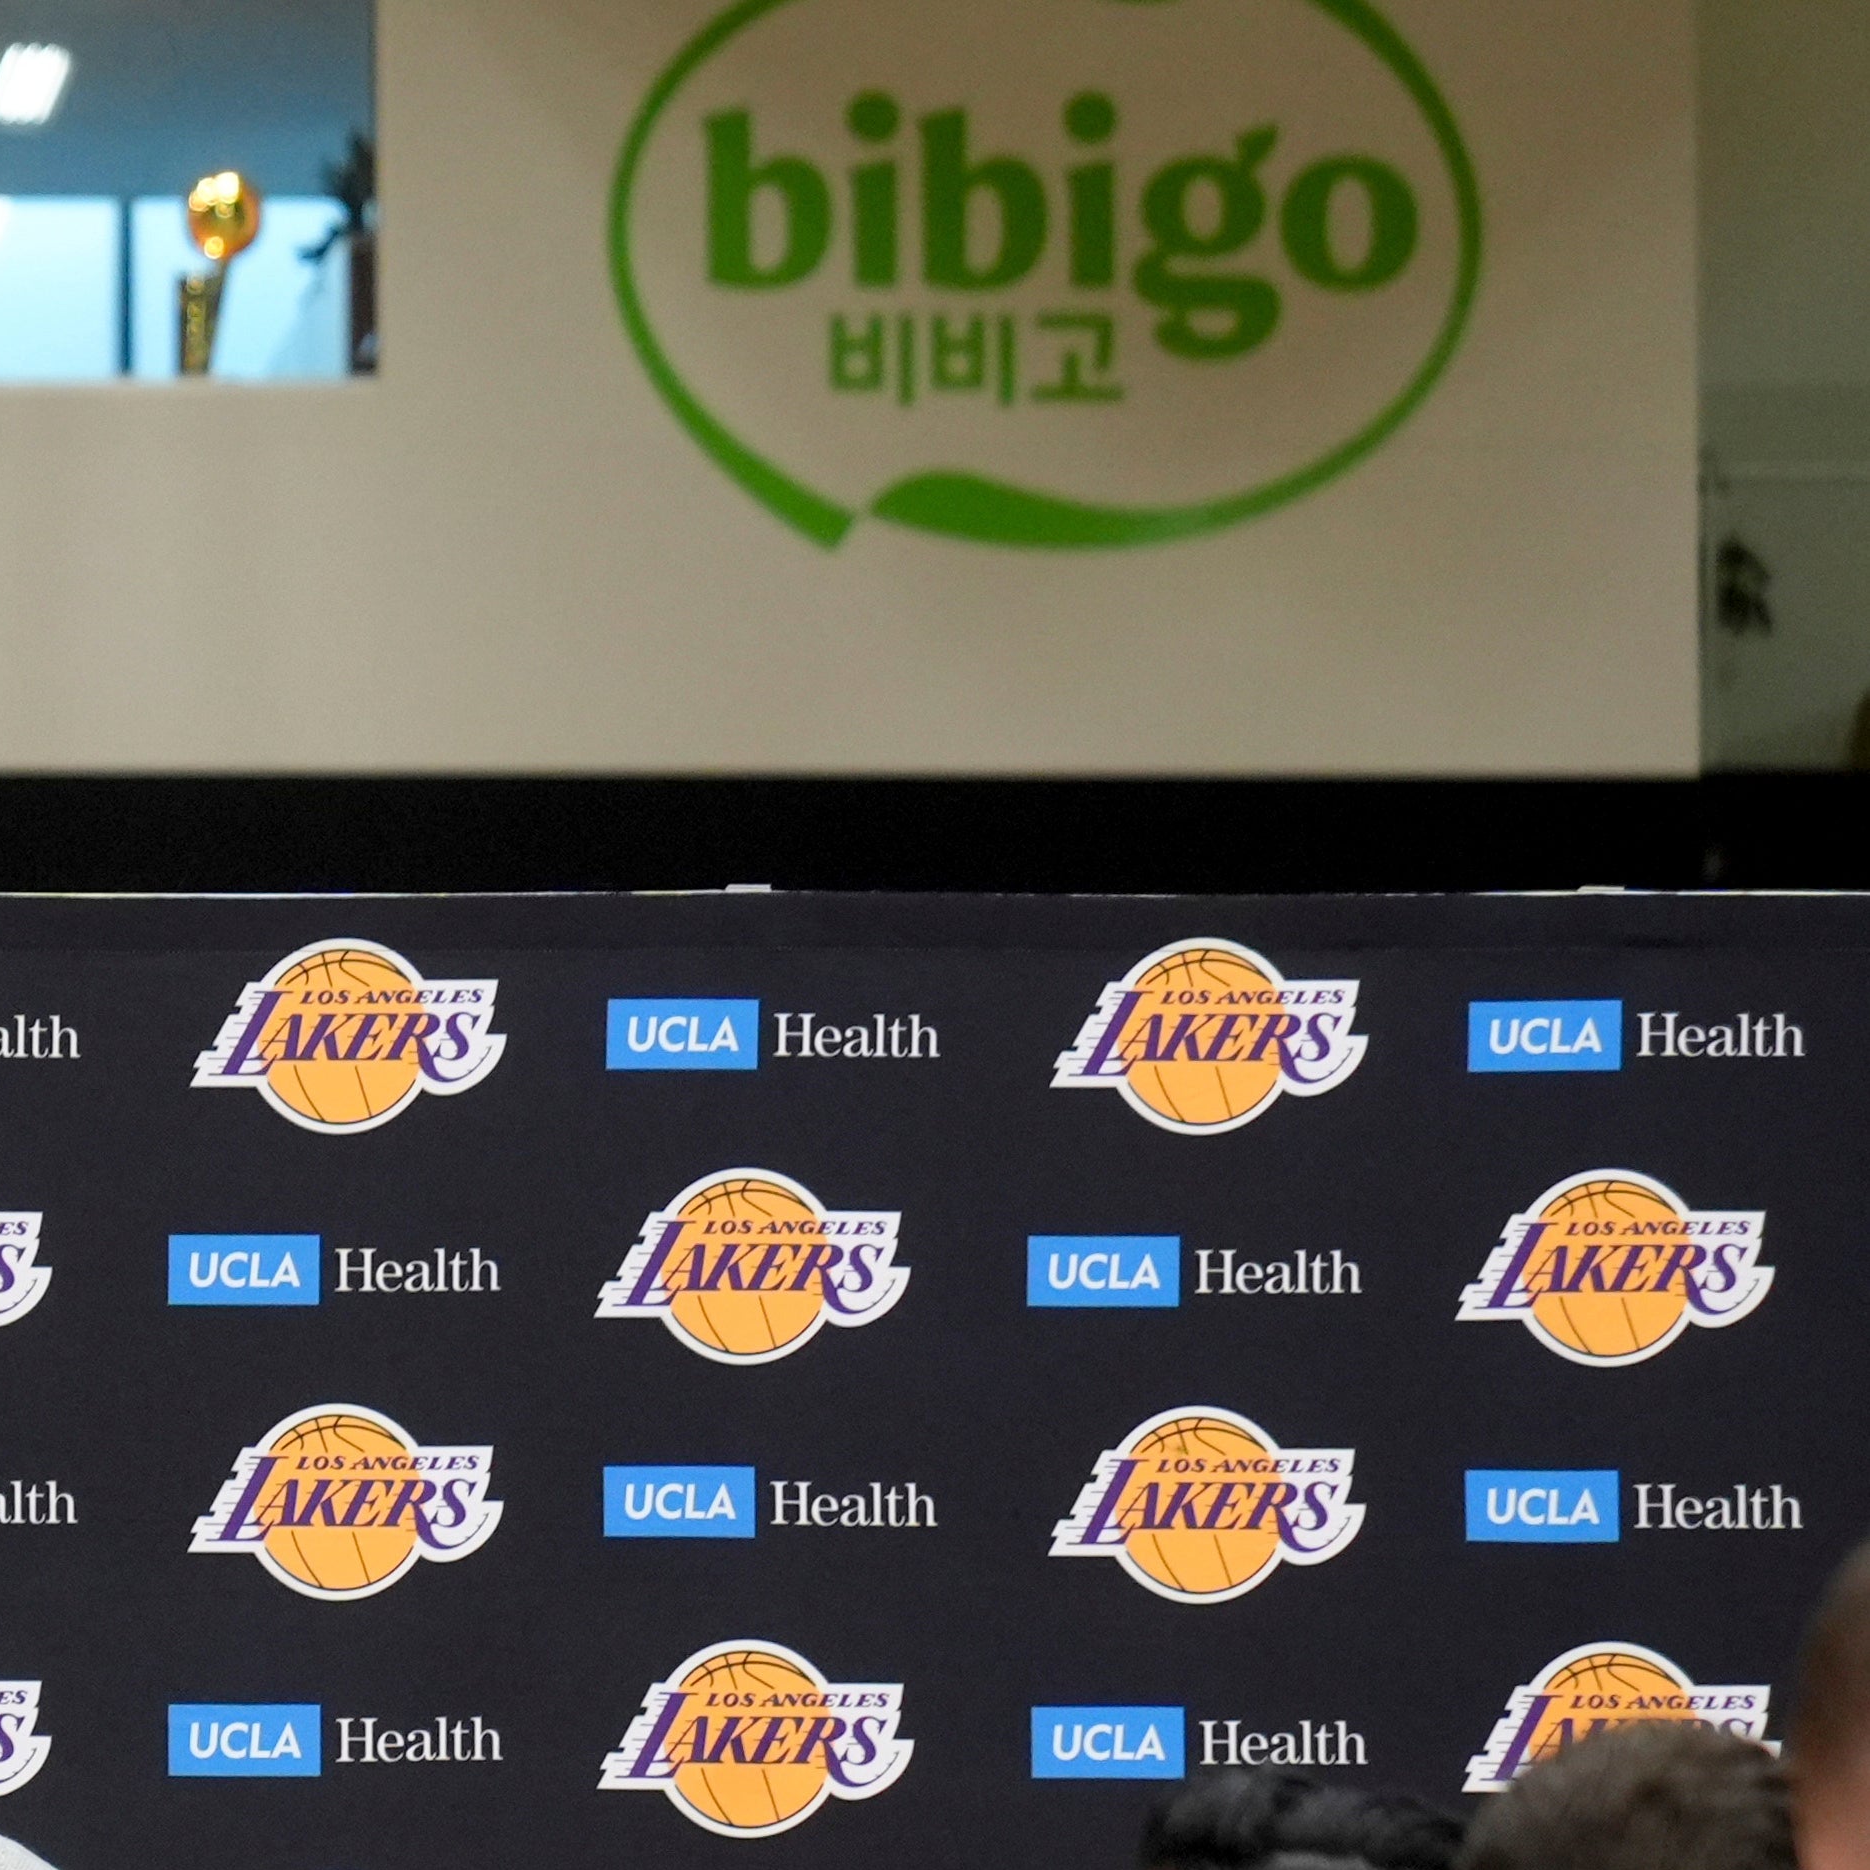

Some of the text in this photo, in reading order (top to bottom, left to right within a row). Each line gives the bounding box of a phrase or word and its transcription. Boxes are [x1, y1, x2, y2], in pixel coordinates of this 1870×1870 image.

[702, 90, 1419, 361] bibigo
[829, 312, 1125, 407] 비비고
[1160, 988, 1346, 1006] LOS ANGELES
[215, 990, 486, 1083] LAKERS
[628, 1013, 940, 1057] UCLA Health
[1075, 990, 1347, 1084] LAKERS
[1489, 1013, 1805, 1057] UCLA Health
[1565, 1219, 1752, 1237] LOS ANGELES
[189, 1248, 501, 1291] UCLA Health
[619, 1219, 889, 1315] LAKERS
[1049, 1250, 1362, 1293] UCLA Health
[1481, 1222, 1753, 1315] LAKERS
[295, 1453, 480, 1472] LOS ANGELES
[213, 1455, 481, 1550] LAKERS
[625, 1481, 937, 1527] UCLA Health
[1073, 1458, 1344, 1553] LAKERS
[1487, 1485, 1802, 1529] UCLA Health
[190, 1717, 503, 1762] UCLA Health
[622, 1691, 892, 1788] LAKERS
[1053, 1721, 1367, 1764] UCLA Health
